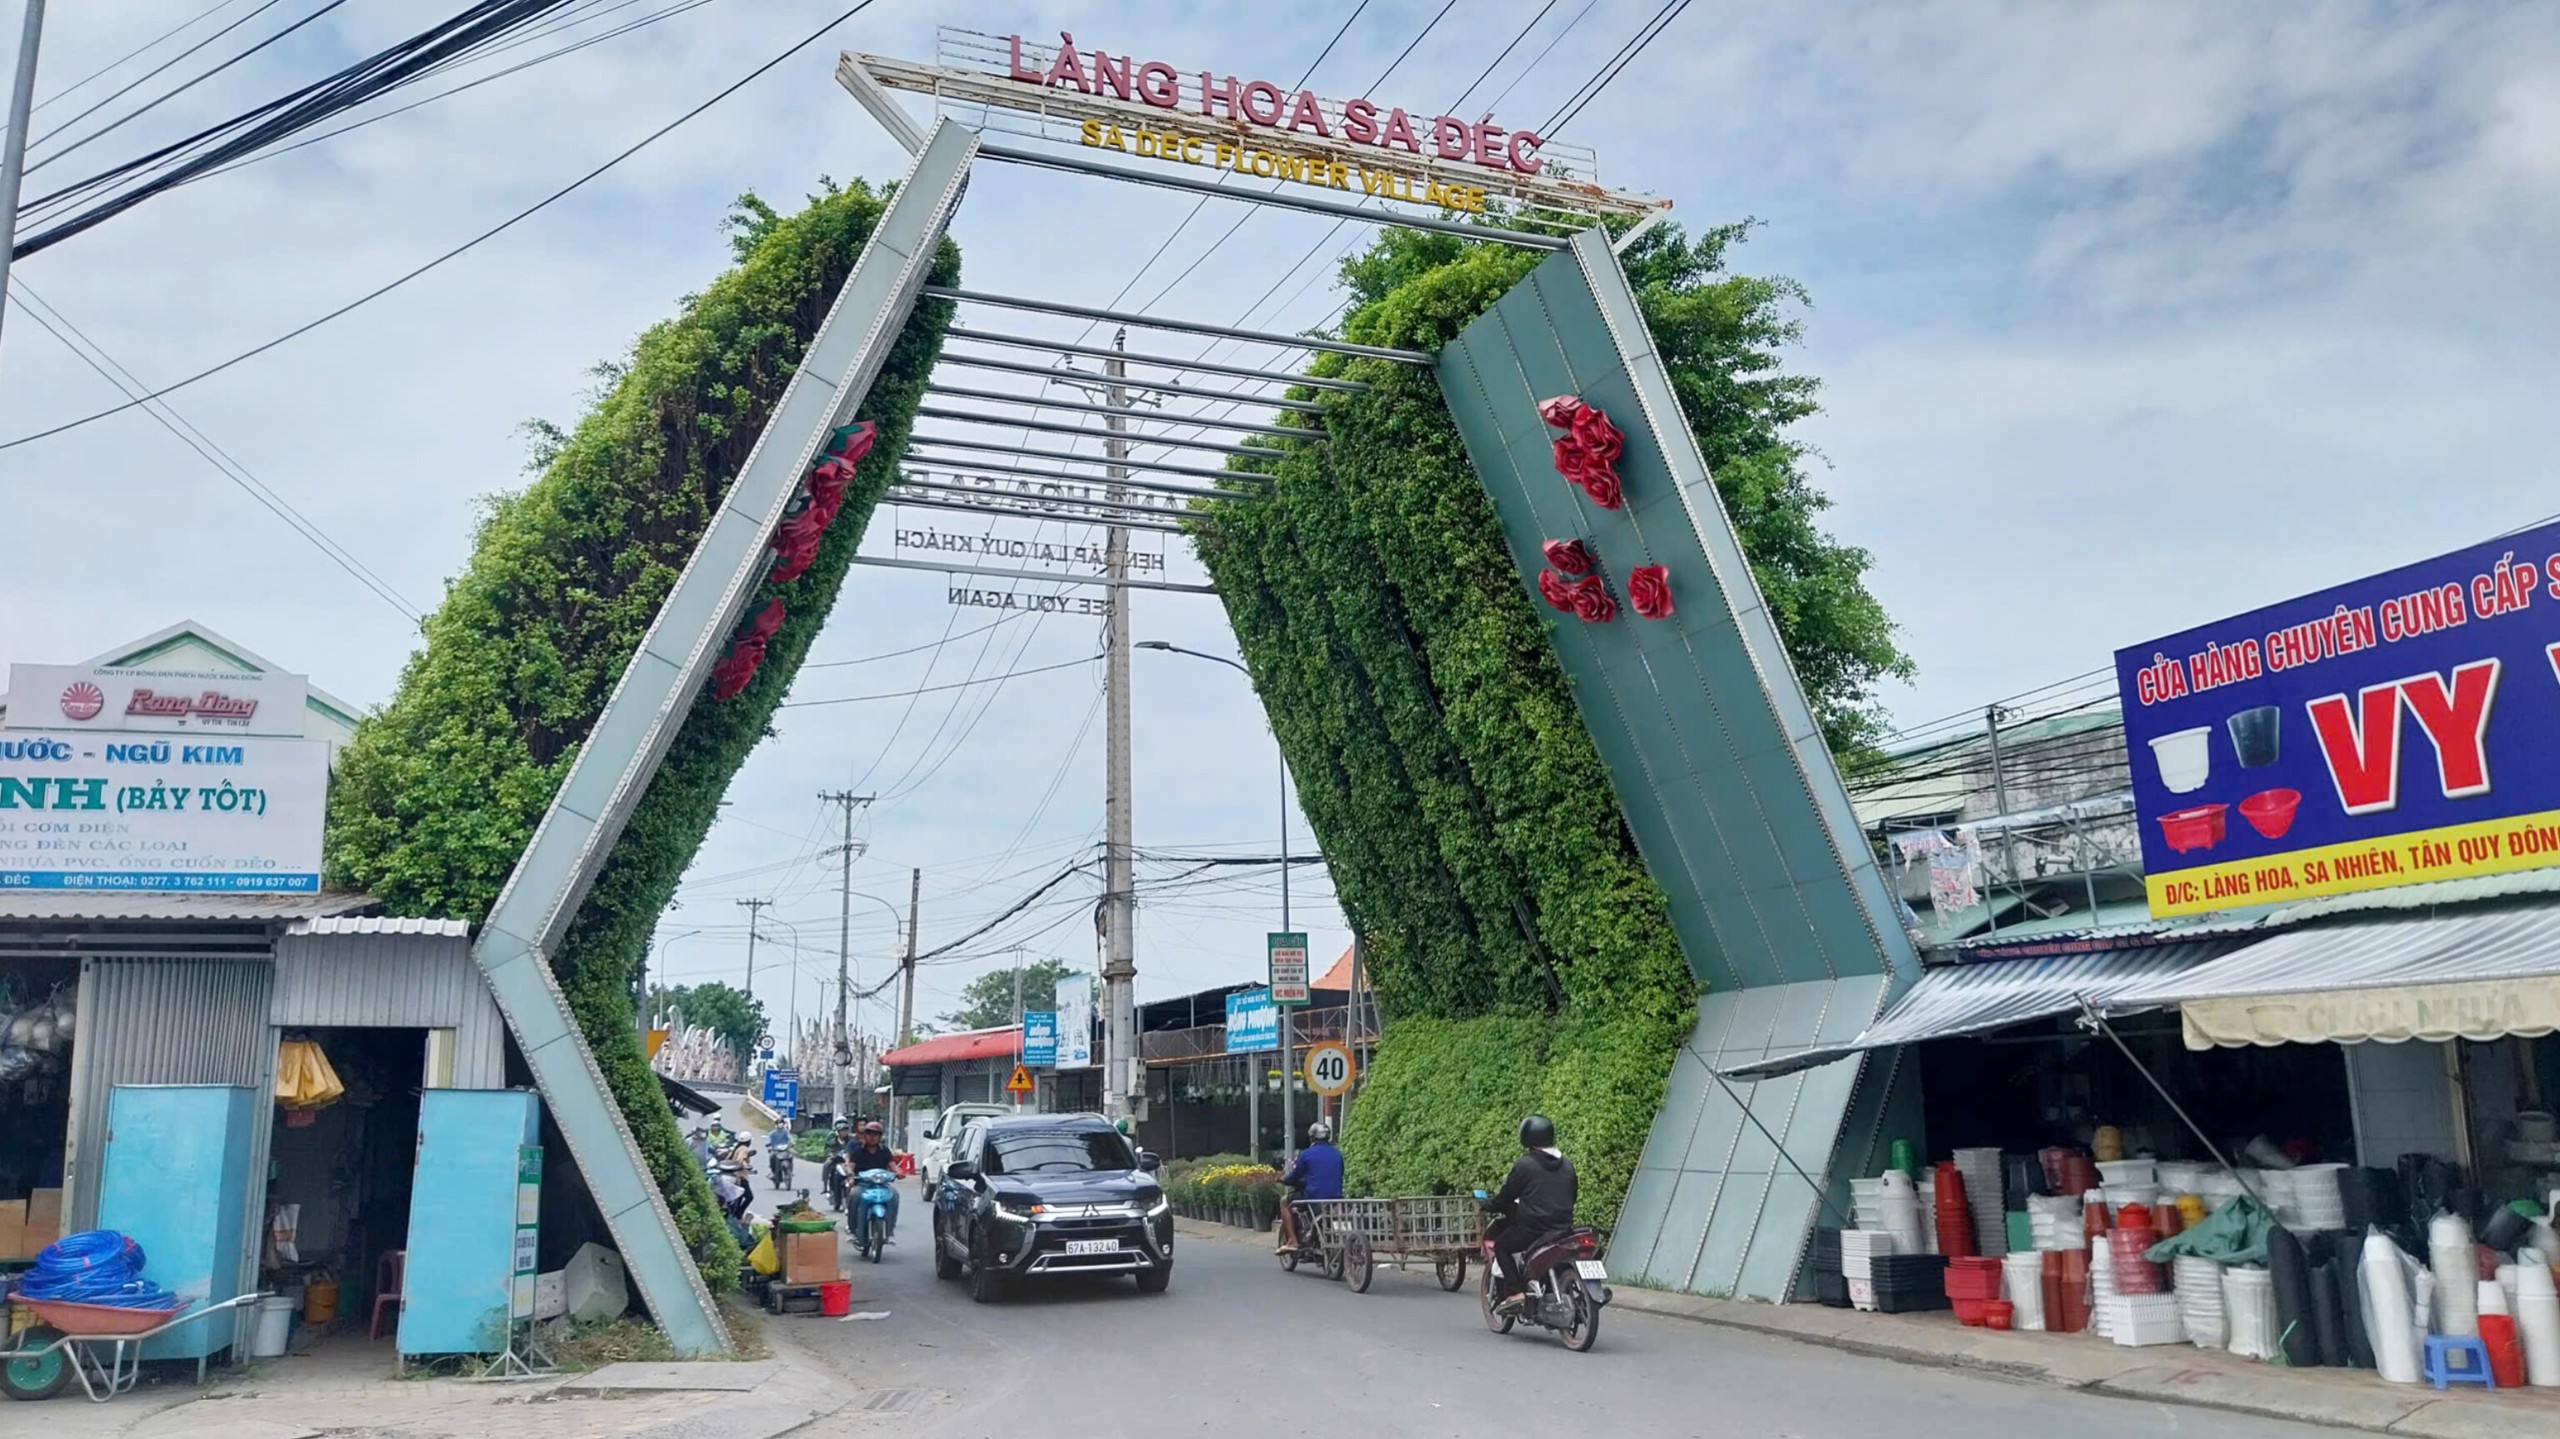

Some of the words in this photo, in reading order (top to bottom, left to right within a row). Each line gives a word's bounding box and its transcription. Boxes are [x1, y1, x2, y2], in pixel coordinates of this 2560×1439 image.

[1010, 31, 1179, 108] LÀNG
[1201, 71, 1329, 138] HOA
[1344, 99, 1420, 154] SA
[1433, 113, 1544, 174] ĐÉC
[1081, 118, 1127, 152] SA
[1135, 130, 1203, 164] DEC
[1215, 143, 1350, 190] FLOWER
[1359, 168, 1486, 214] VILLAGE
[2137, 652, 2189, 706] CỬA
[2189, 641, 2262, 693] HÀNG
[2265, 604, 2376, 672] CHUYÊN
[2380, 582, 2467, 642] CUNG
[2471, 551, 2538, 619] CẤP
[0, 737, 72, 762] ƯỚC
[106, 740, 171, 764] NGŨ
[182, 745, 244, 764] KIM
[2305, 657, 2501, 816] VY
[117, 778, 191, 814] (BẢY
[199, 778, 266, 816] TỐT)
[64, 875, 93, 887] ĐIỆN
[96, 876, 137, 888] THOẠI:
[140, 876, 170, 886] 0277.
[174, 877, 181, 886] 3
[184, 878, 205, 887] 762
[208, 878, 226, 887] 111
[236, 878, 263, 887] 0919
[265, 878, 286, 887] 637
[288, 879, 308, 887] 007
[2165, 881, 2200, 905] Đ/C:
[2203, 872, 2250, 900] LÀNG
[2255, 867, 2299, 890] HOA,
[2303, 861, 2330, 884] SA
[2334, 849, 2404, 881] NHIÊN,
[2408, 837, 2453, 870] TÂN
[2457, 834, 2502, 864] QUY
[2508, 823, 2560, 856] ĐÔN
[1316, 1057, 1343, 1081] 40
